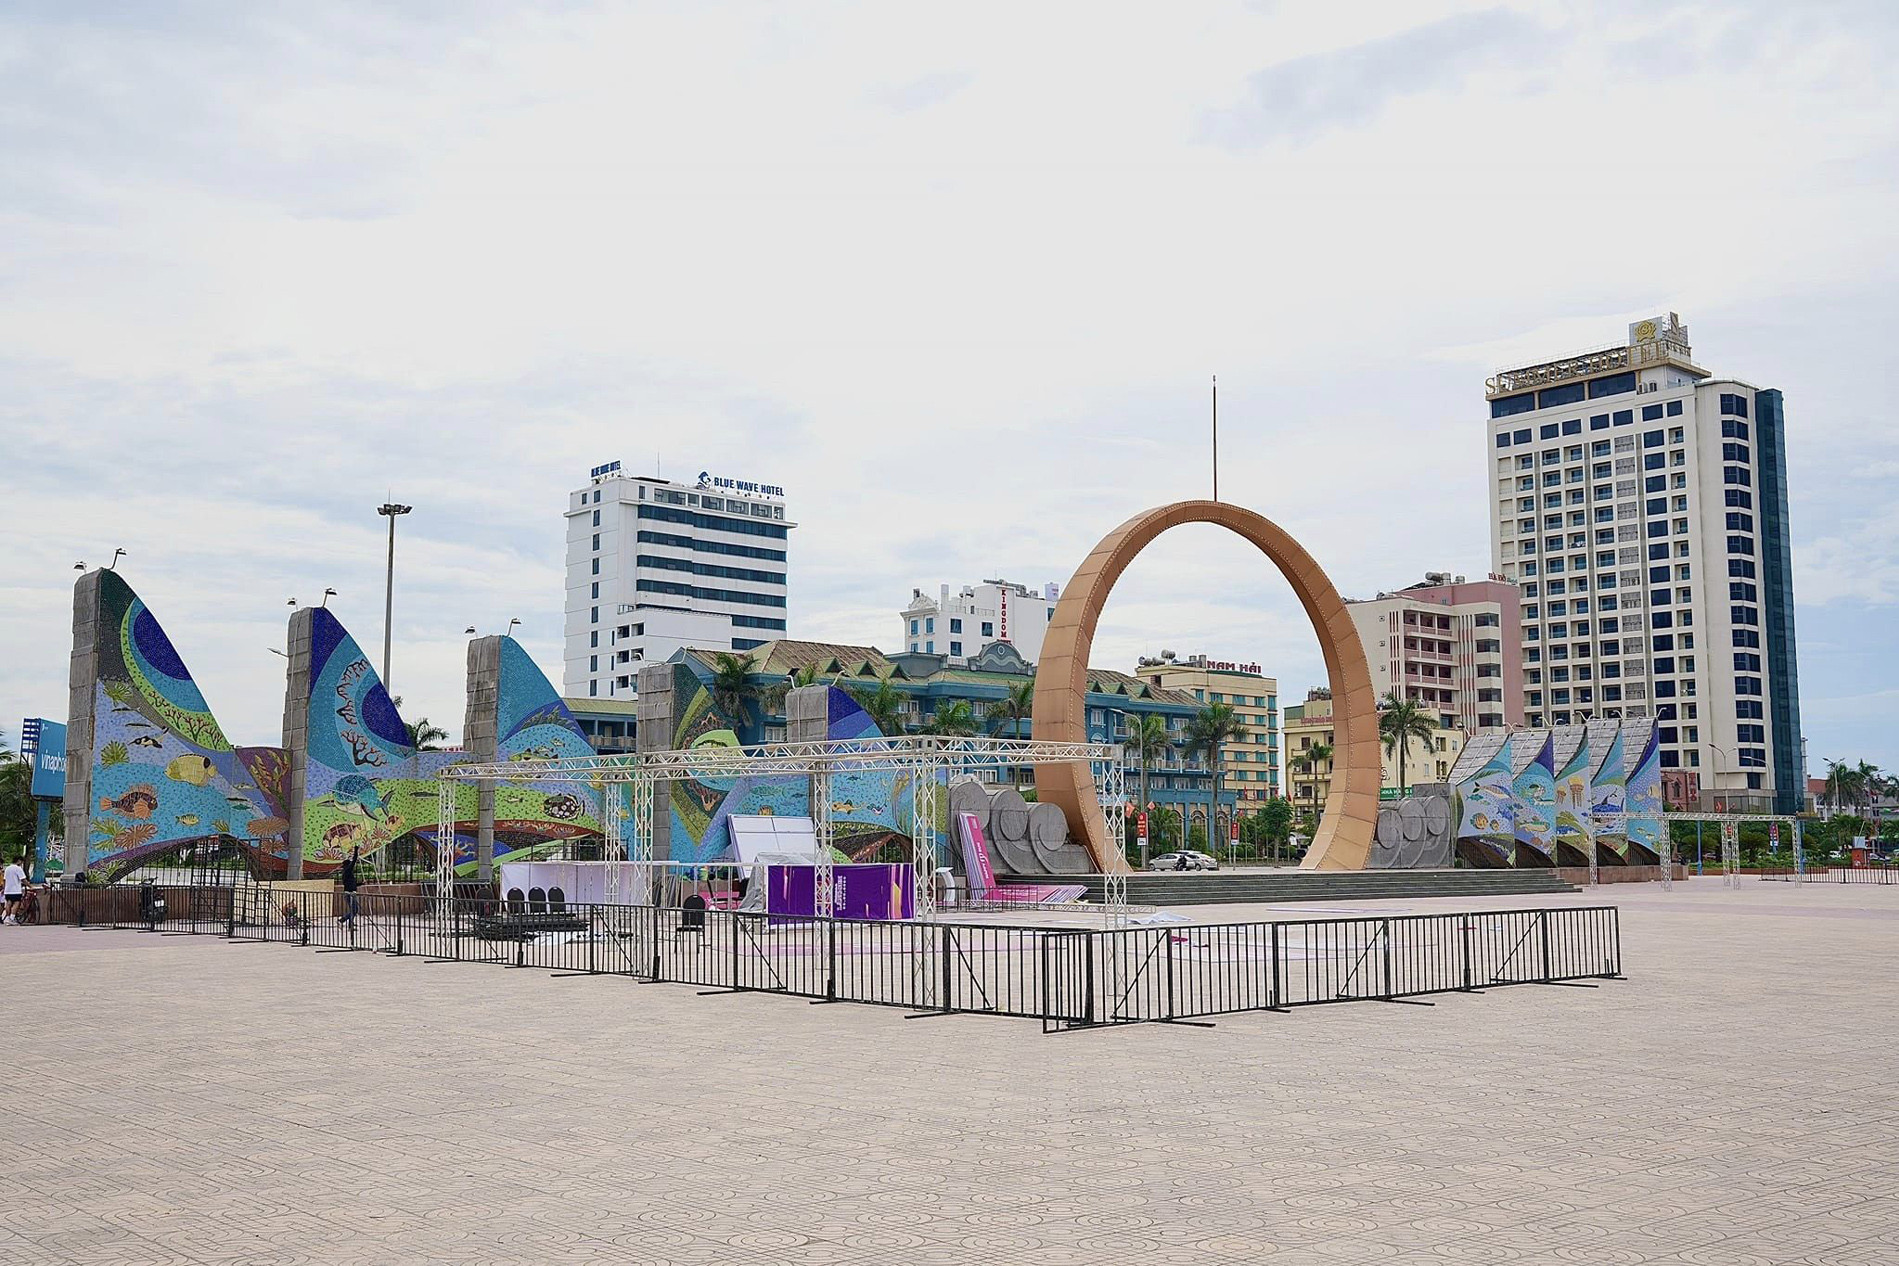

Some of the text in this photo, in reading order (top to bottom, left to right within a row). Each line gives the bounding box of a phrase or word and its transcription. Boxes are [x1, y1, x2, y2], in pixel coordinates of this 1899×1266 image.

[714, 477, 784, 496] BLUE WAVE HOTEL
[1207, 660, 1261, 673] NAM HẢI
[41, 749, 67, 774] vinapho
